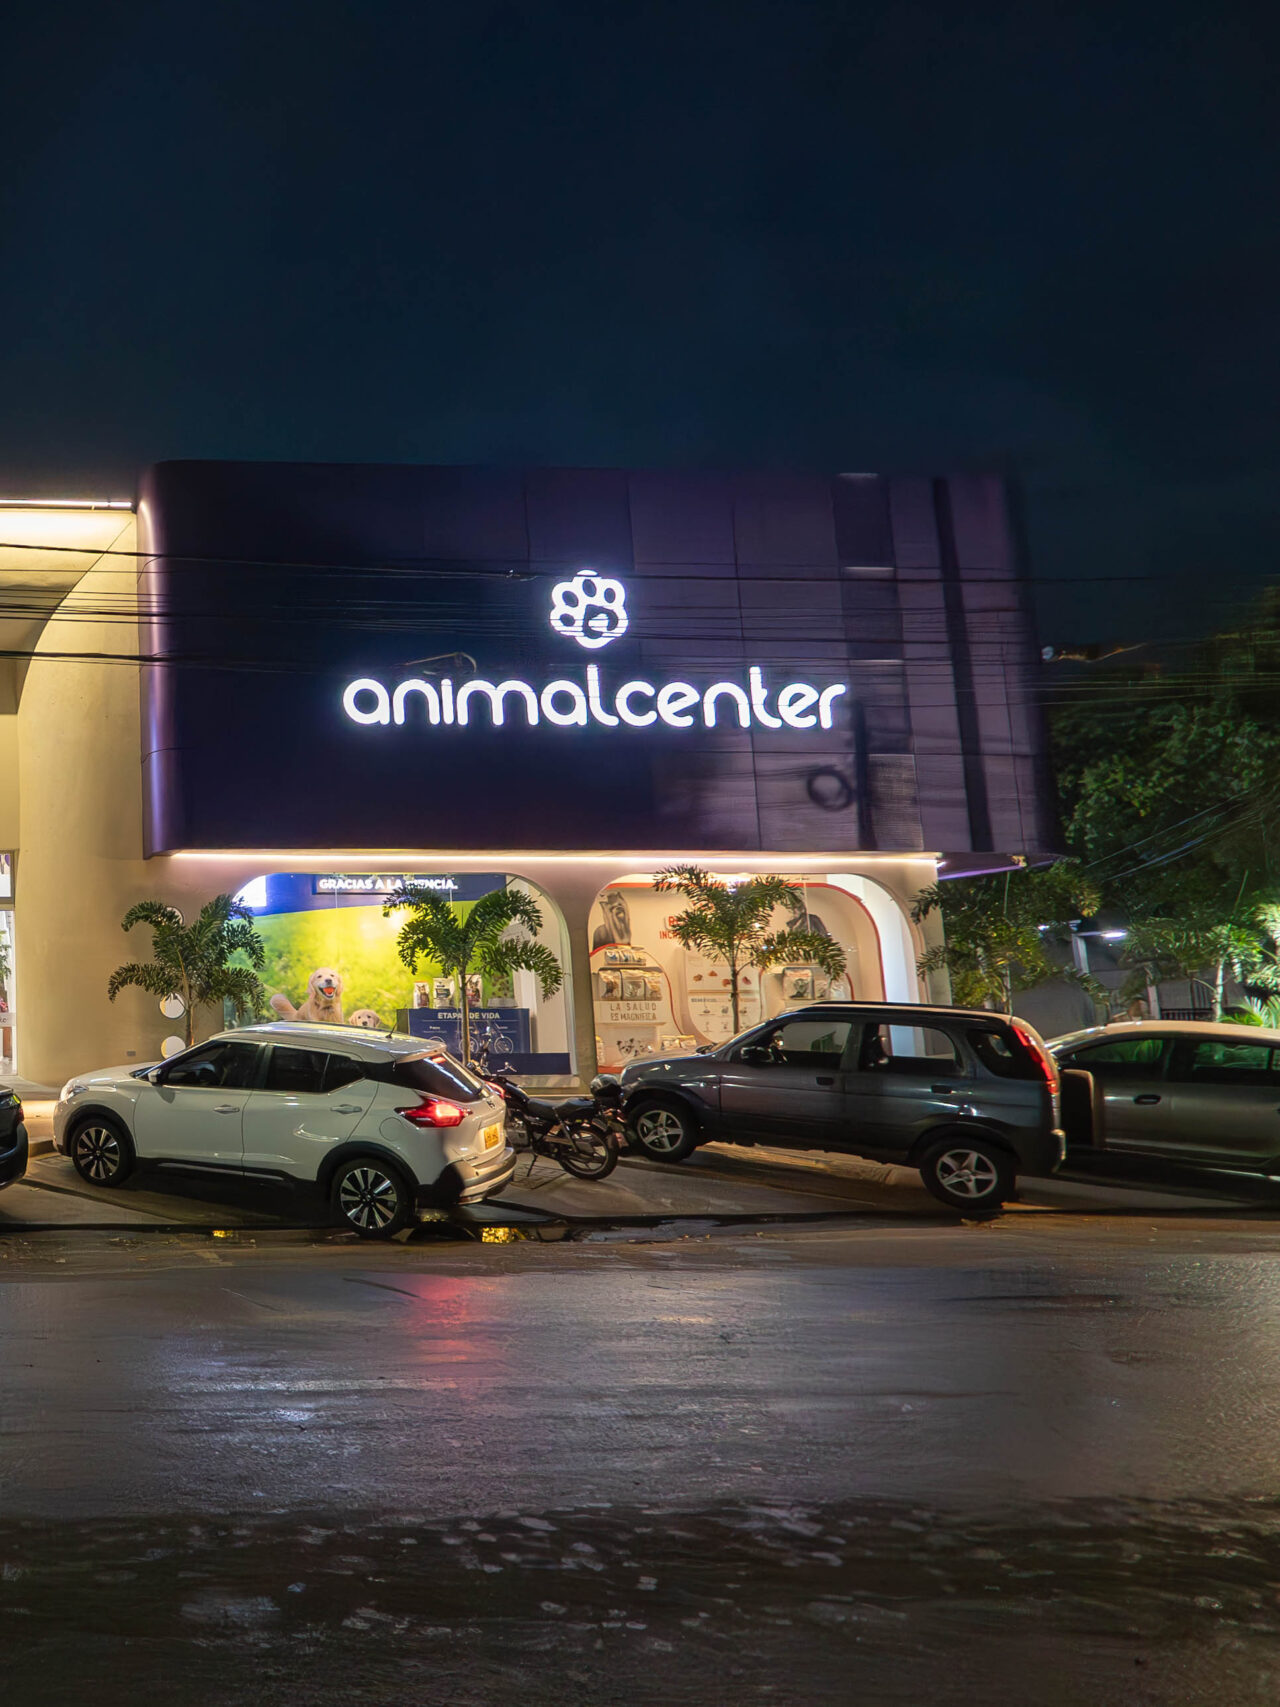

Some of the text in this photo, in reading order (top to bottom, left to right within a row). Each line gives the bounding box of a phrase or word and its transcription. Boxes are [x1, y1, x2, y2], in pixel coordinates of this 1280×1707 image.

[342, 663, 848, 729] animalcenter
[319, 878, 374, 890] GRACIAS
[374, 879, 386, 890] A
[386, 879, 403, 890] LA
[610, 1002, 657, 1011] LA SALUD
[469, 1012, 480, 1020] DE
[481, 1012, 501, 1020] VIDA
